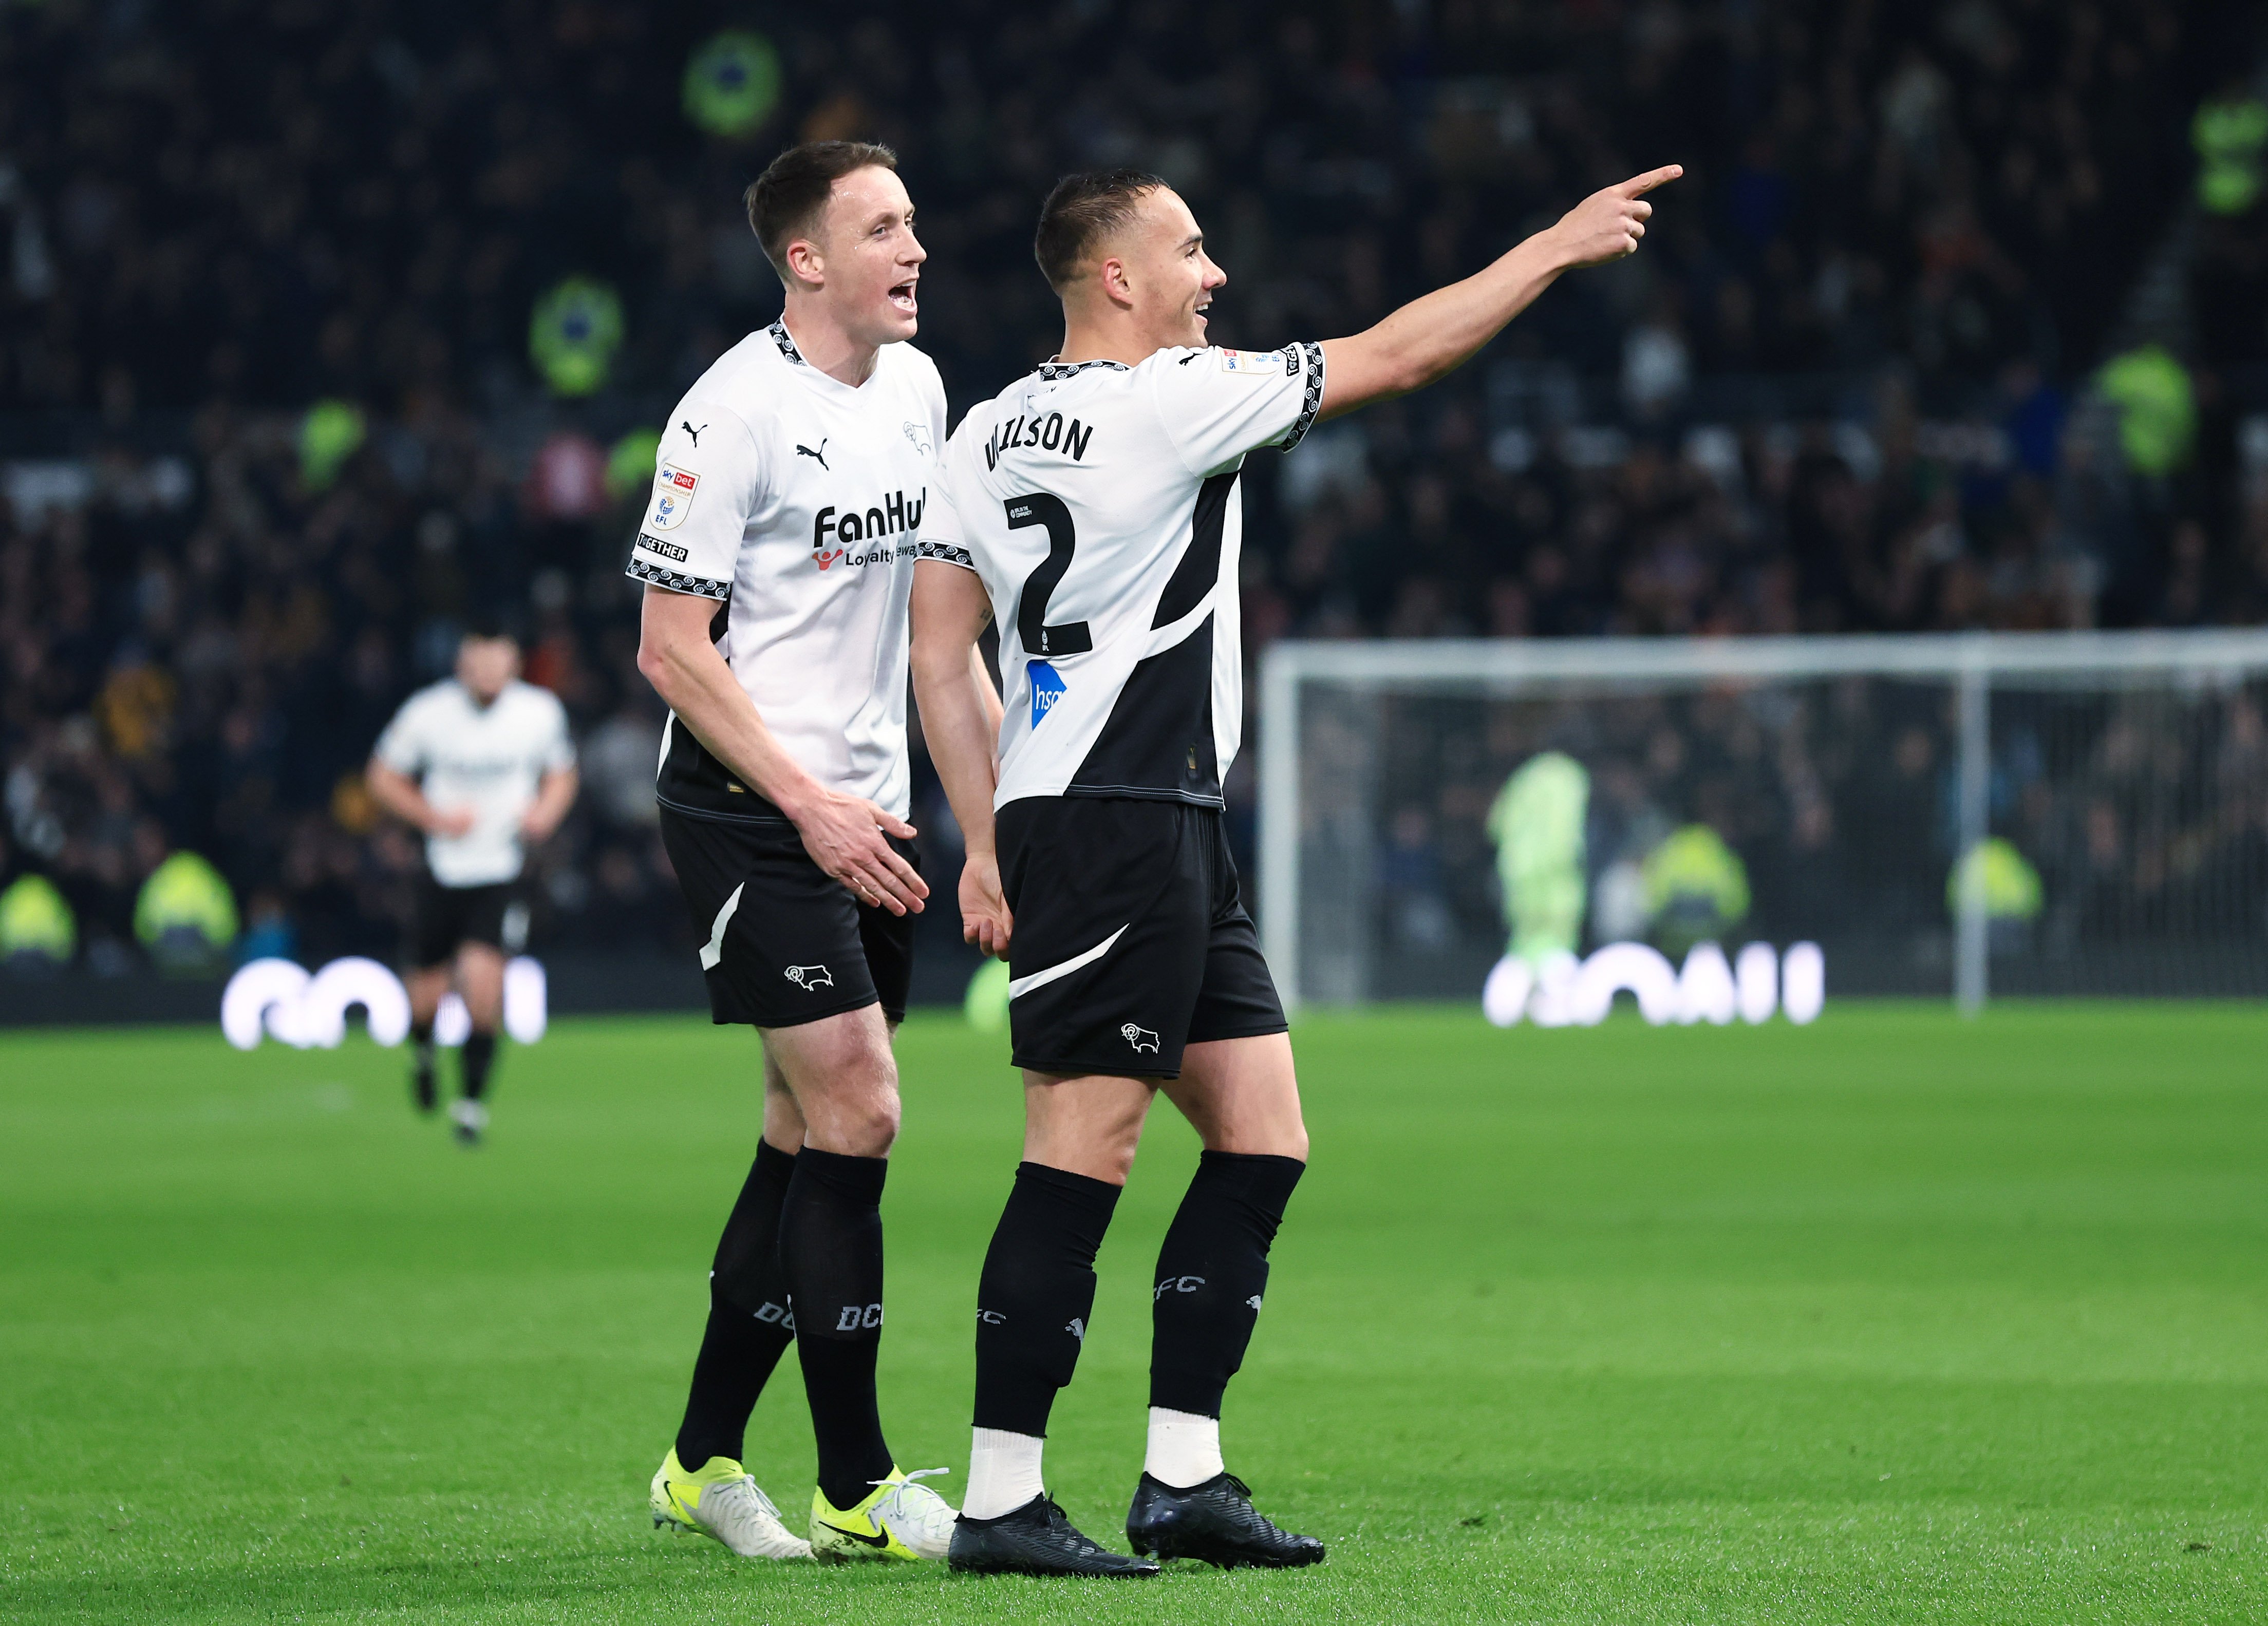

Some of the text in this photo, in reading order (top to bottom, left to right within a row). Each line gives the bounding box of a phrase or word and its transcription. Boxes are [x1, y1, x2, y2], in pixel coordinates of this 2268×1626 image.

[1227, 357, 1237, 369] sky
[985, 412, 1094, 472] WILSON
[658, 482, 691, 496] CHAMPIONSHIP
[663, 469, 693, 487] sky bet
[655, 515, 667, 525] EFL
[639, 534, 686, 561] TOGETHER
[846, 545, 917, 568] Loyalty ewa
[1003, 493, 1093, 656] 2
[836, 1303, 884, 1331] DC
